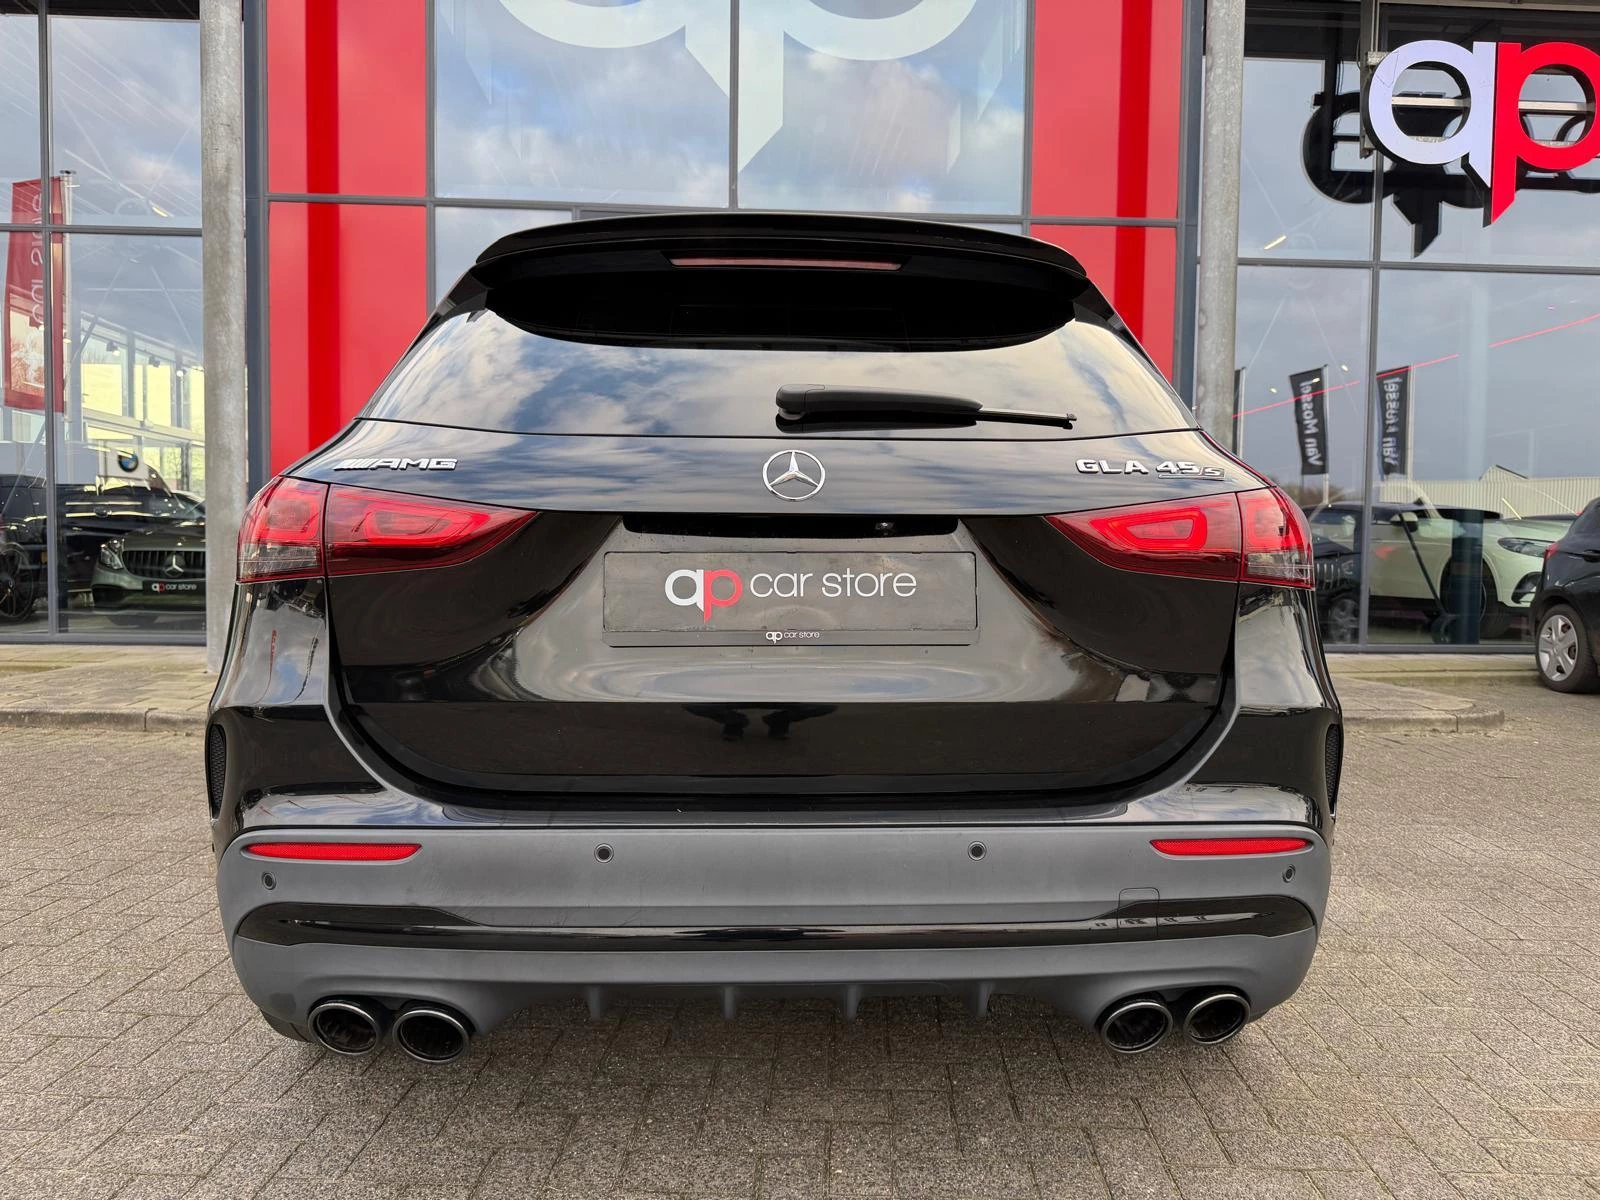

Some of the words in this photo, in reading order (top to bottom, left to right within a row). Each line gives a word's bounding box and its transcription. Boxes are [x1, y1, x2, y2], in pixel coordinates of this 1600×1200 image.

[366, 458, 458, 471] AMG
[1076, 458, 1149, 474] GLA
[750, 571, 813, 598] car
[821, 567, 917, 598] store
[783, 631, 797, 639] car
[798, 631, 820, 639] store
